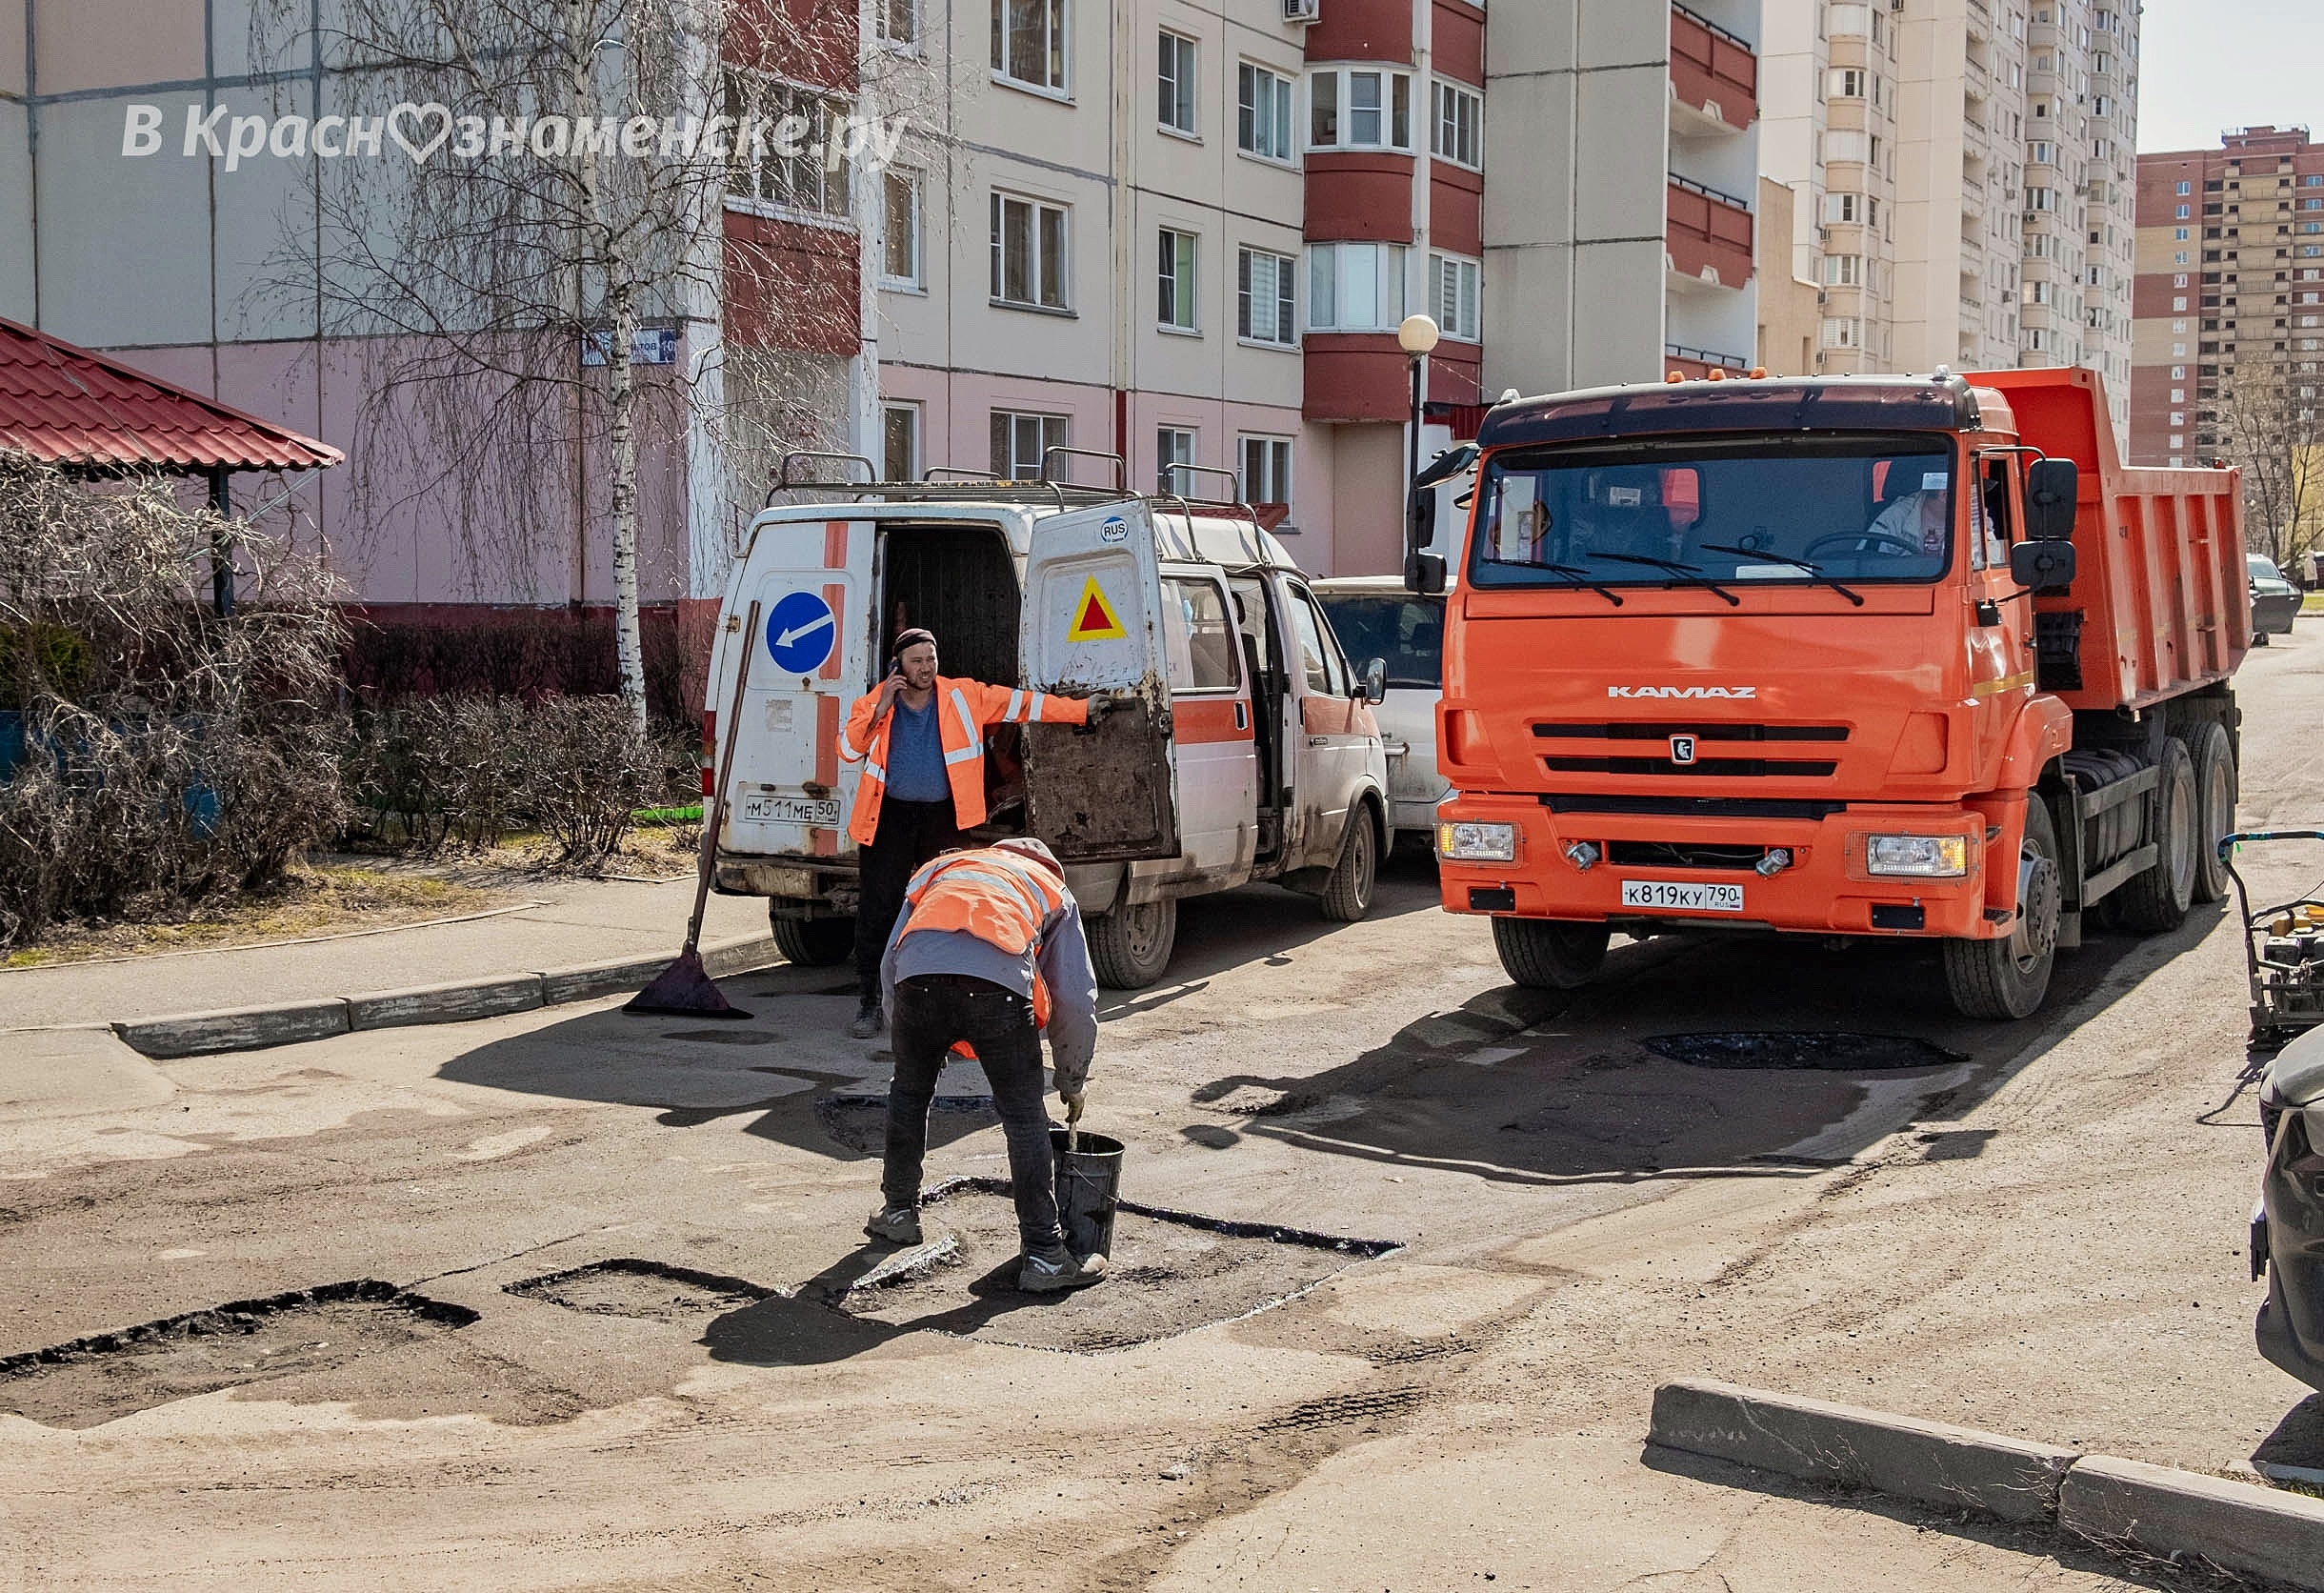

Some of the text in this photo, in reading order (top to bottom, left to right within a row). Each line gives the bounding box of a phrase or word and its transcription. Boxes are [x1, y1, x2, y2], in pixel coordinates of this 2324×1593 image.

[1104, 523, 1126, 536] RUS
[1608, 686, 1756, 698] KAMAZ
[817, 802, 834, 816] 50
[1629, 885, 1737, 906] К819КУ 790
